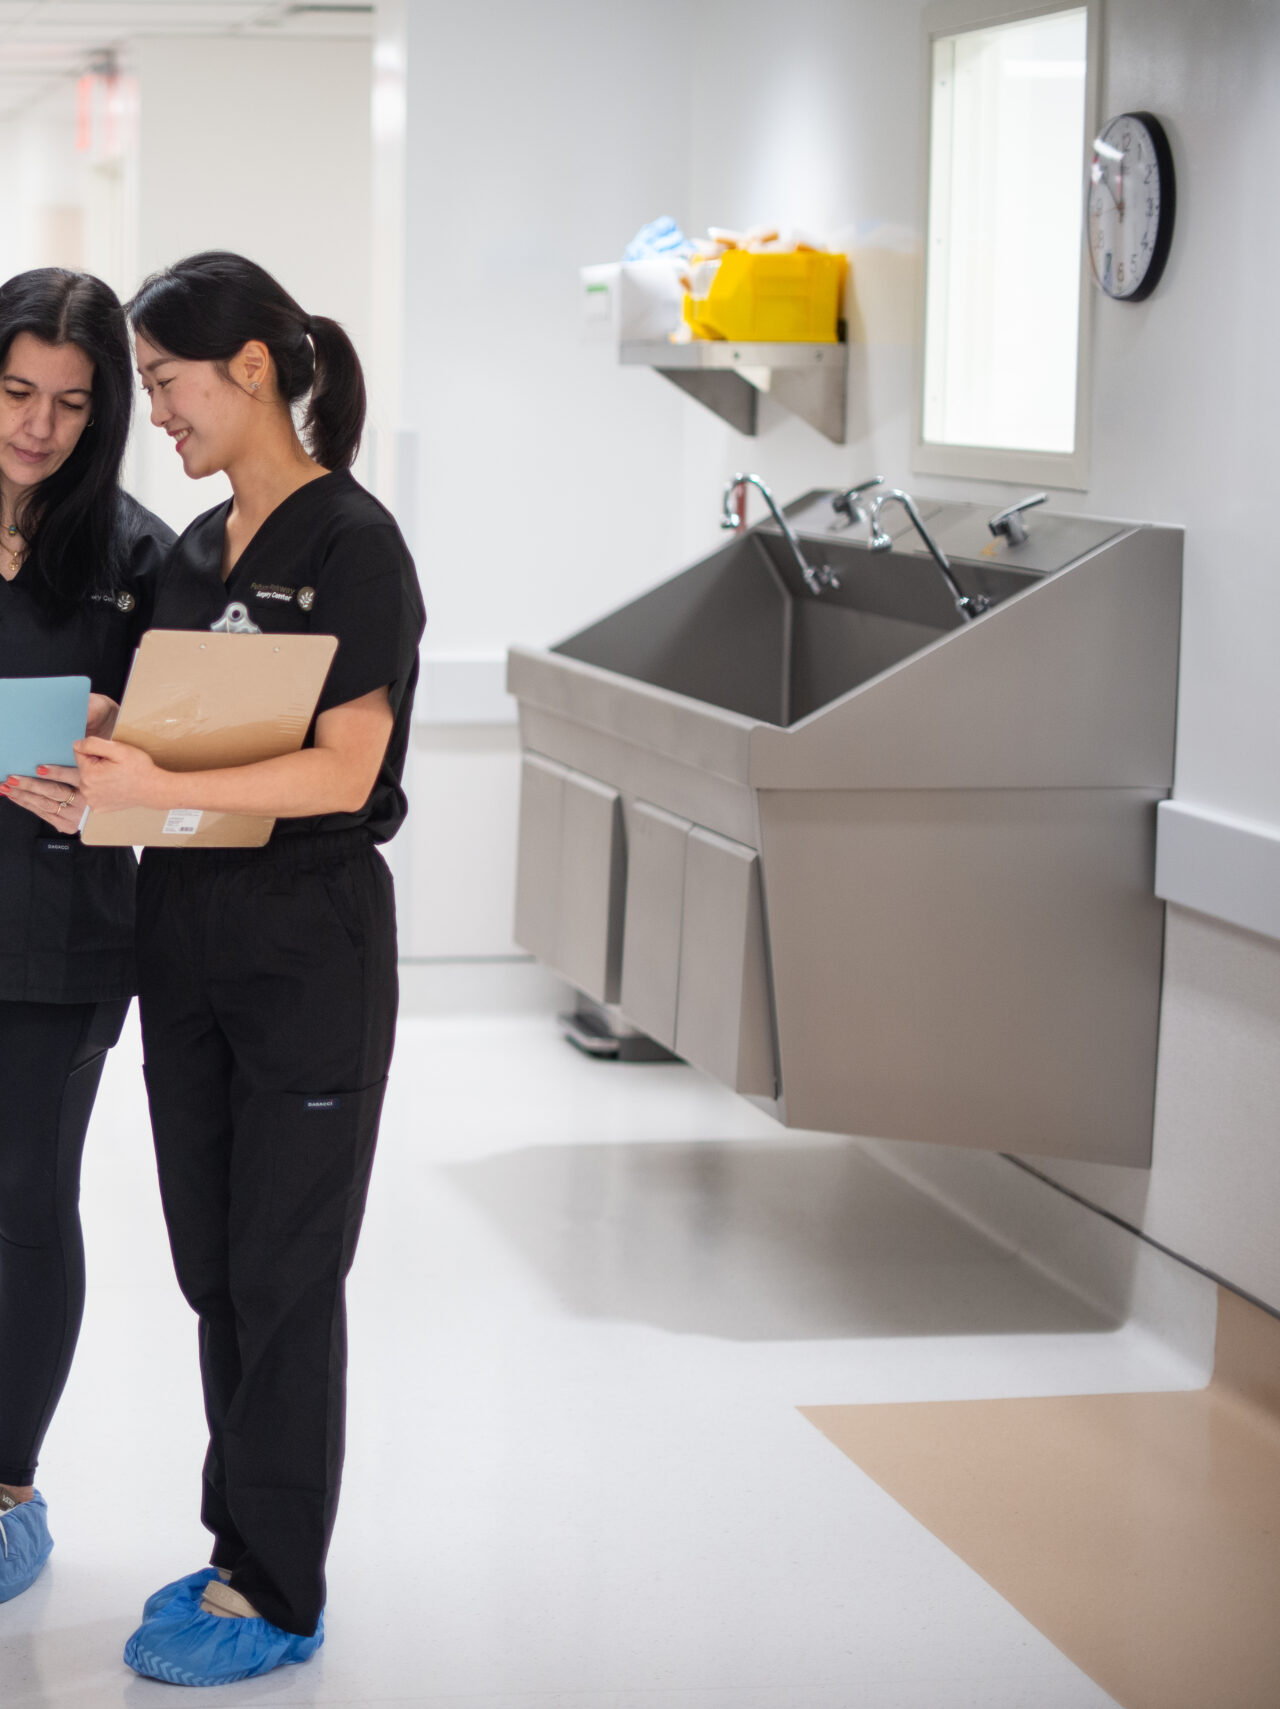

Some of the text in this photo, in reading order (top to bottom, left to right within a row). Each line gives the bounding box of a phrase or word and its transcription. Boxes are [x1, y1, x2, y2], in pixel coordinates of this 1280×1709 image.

[1144, 164, 1154, 184] 2
[1146, 198, 1154, 218] 3
[1141, 231, 1149, 250] 4
[1117, 262, 1125, 282] 6
[271, 591, 293, 602] Center
